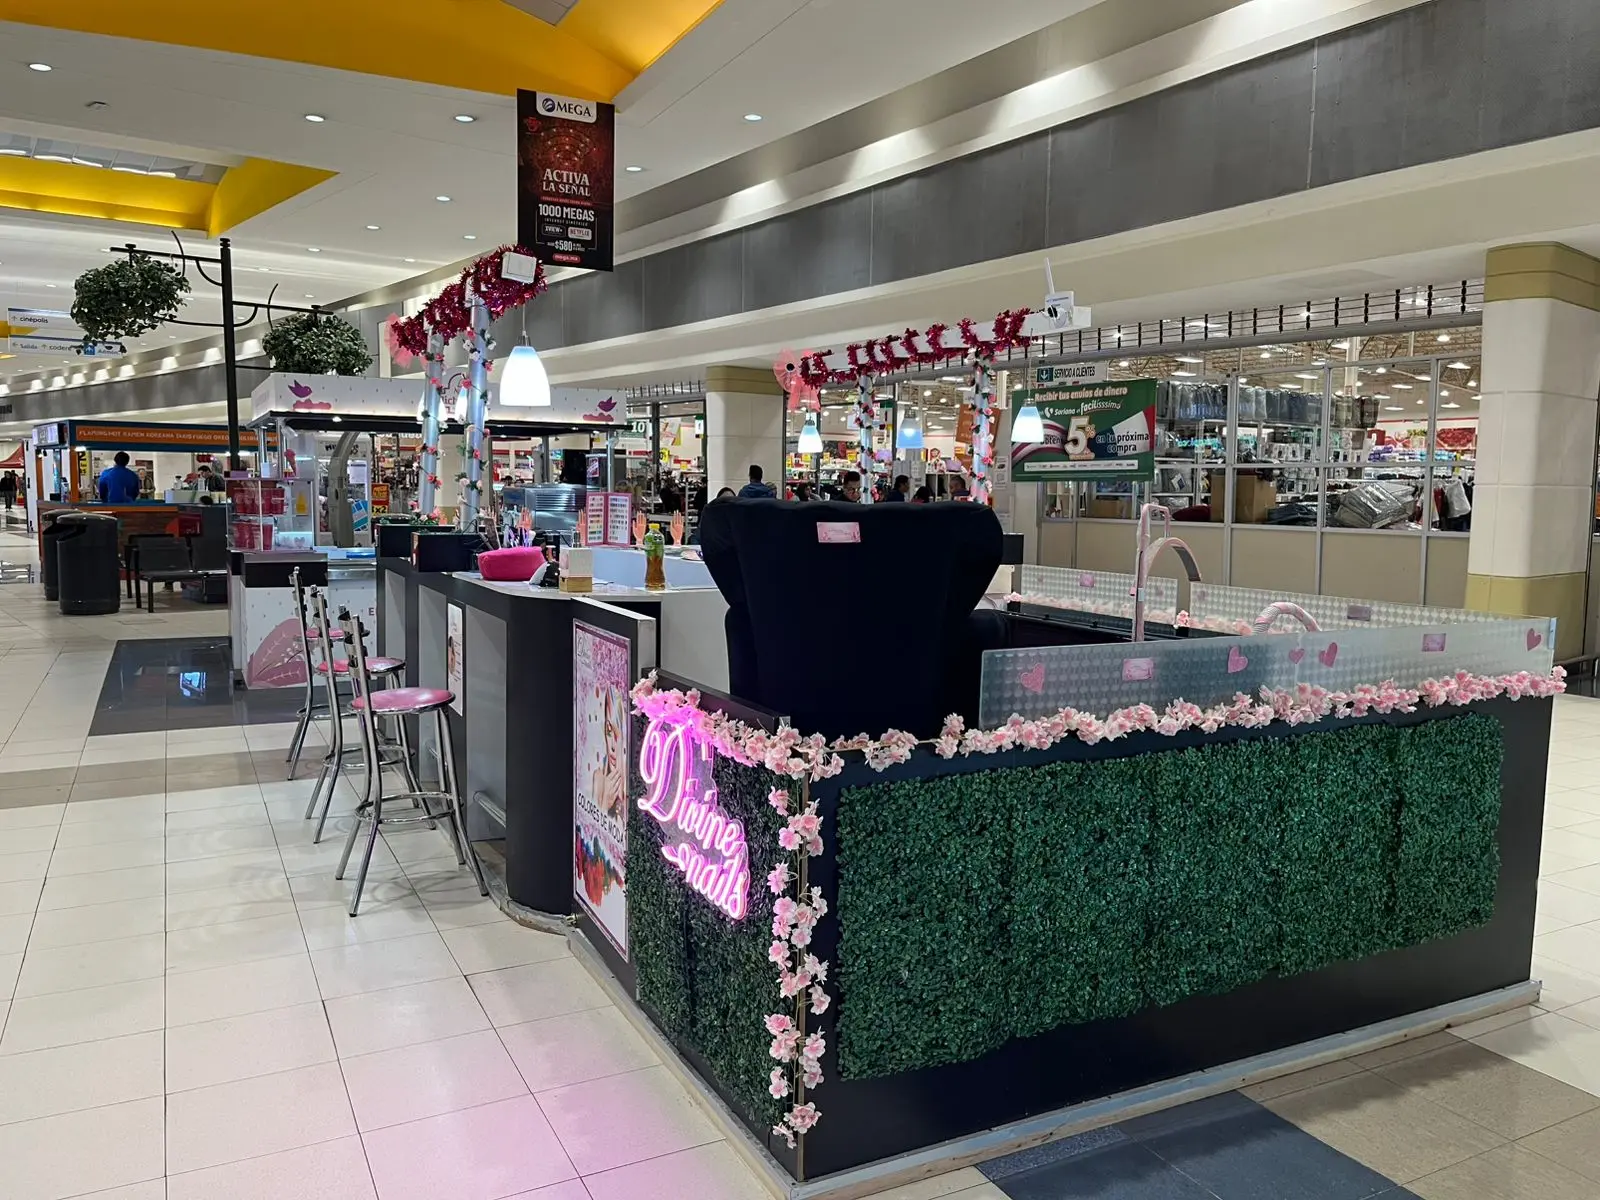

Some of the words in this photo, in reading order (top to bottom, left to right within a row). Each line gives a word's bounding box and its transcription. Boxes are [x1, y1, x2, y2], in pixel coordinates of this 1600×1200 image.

[556, 101, 591, 117] MEGA
[543, 168, 590, 186] ACTIVA
[542, 181, 556, 192] LA
[558, 183, 591, 197] SEÑAL
[538, 203, 562, 218] 1000
[562, 206, 595, 222] MEGAS
[554, 240, 573, 252] $580
[1054, 369, 1072, 379] SERVICIO
[1076, 366, 1096, 378] CLIENTES
[1034, 391, 1058, 402] Recibir
[1058, 391, 1070, 400] tus
[1070, 387, 1093, 399] envíos
[1094, 387, 1104, 397] de
[1103, 386, 1128, 397] dinero
[1054, 408, 1076, 416] Soriana
[631, 420, 646, 433] 10
[1095, 435, 1106, 444] en
[1106, 433, 1117, 444] tu
[1117, 431, 1150, 446] próxima
[1107, 443, 1137, 454] compra
[637, 718, 747, 858] Divine
[577, 792, 600, 823] COLORES
[600, 811, 608, 832] DE
[608, 819, 625, 844] MODA
[660, 845, 751, 921] nails
